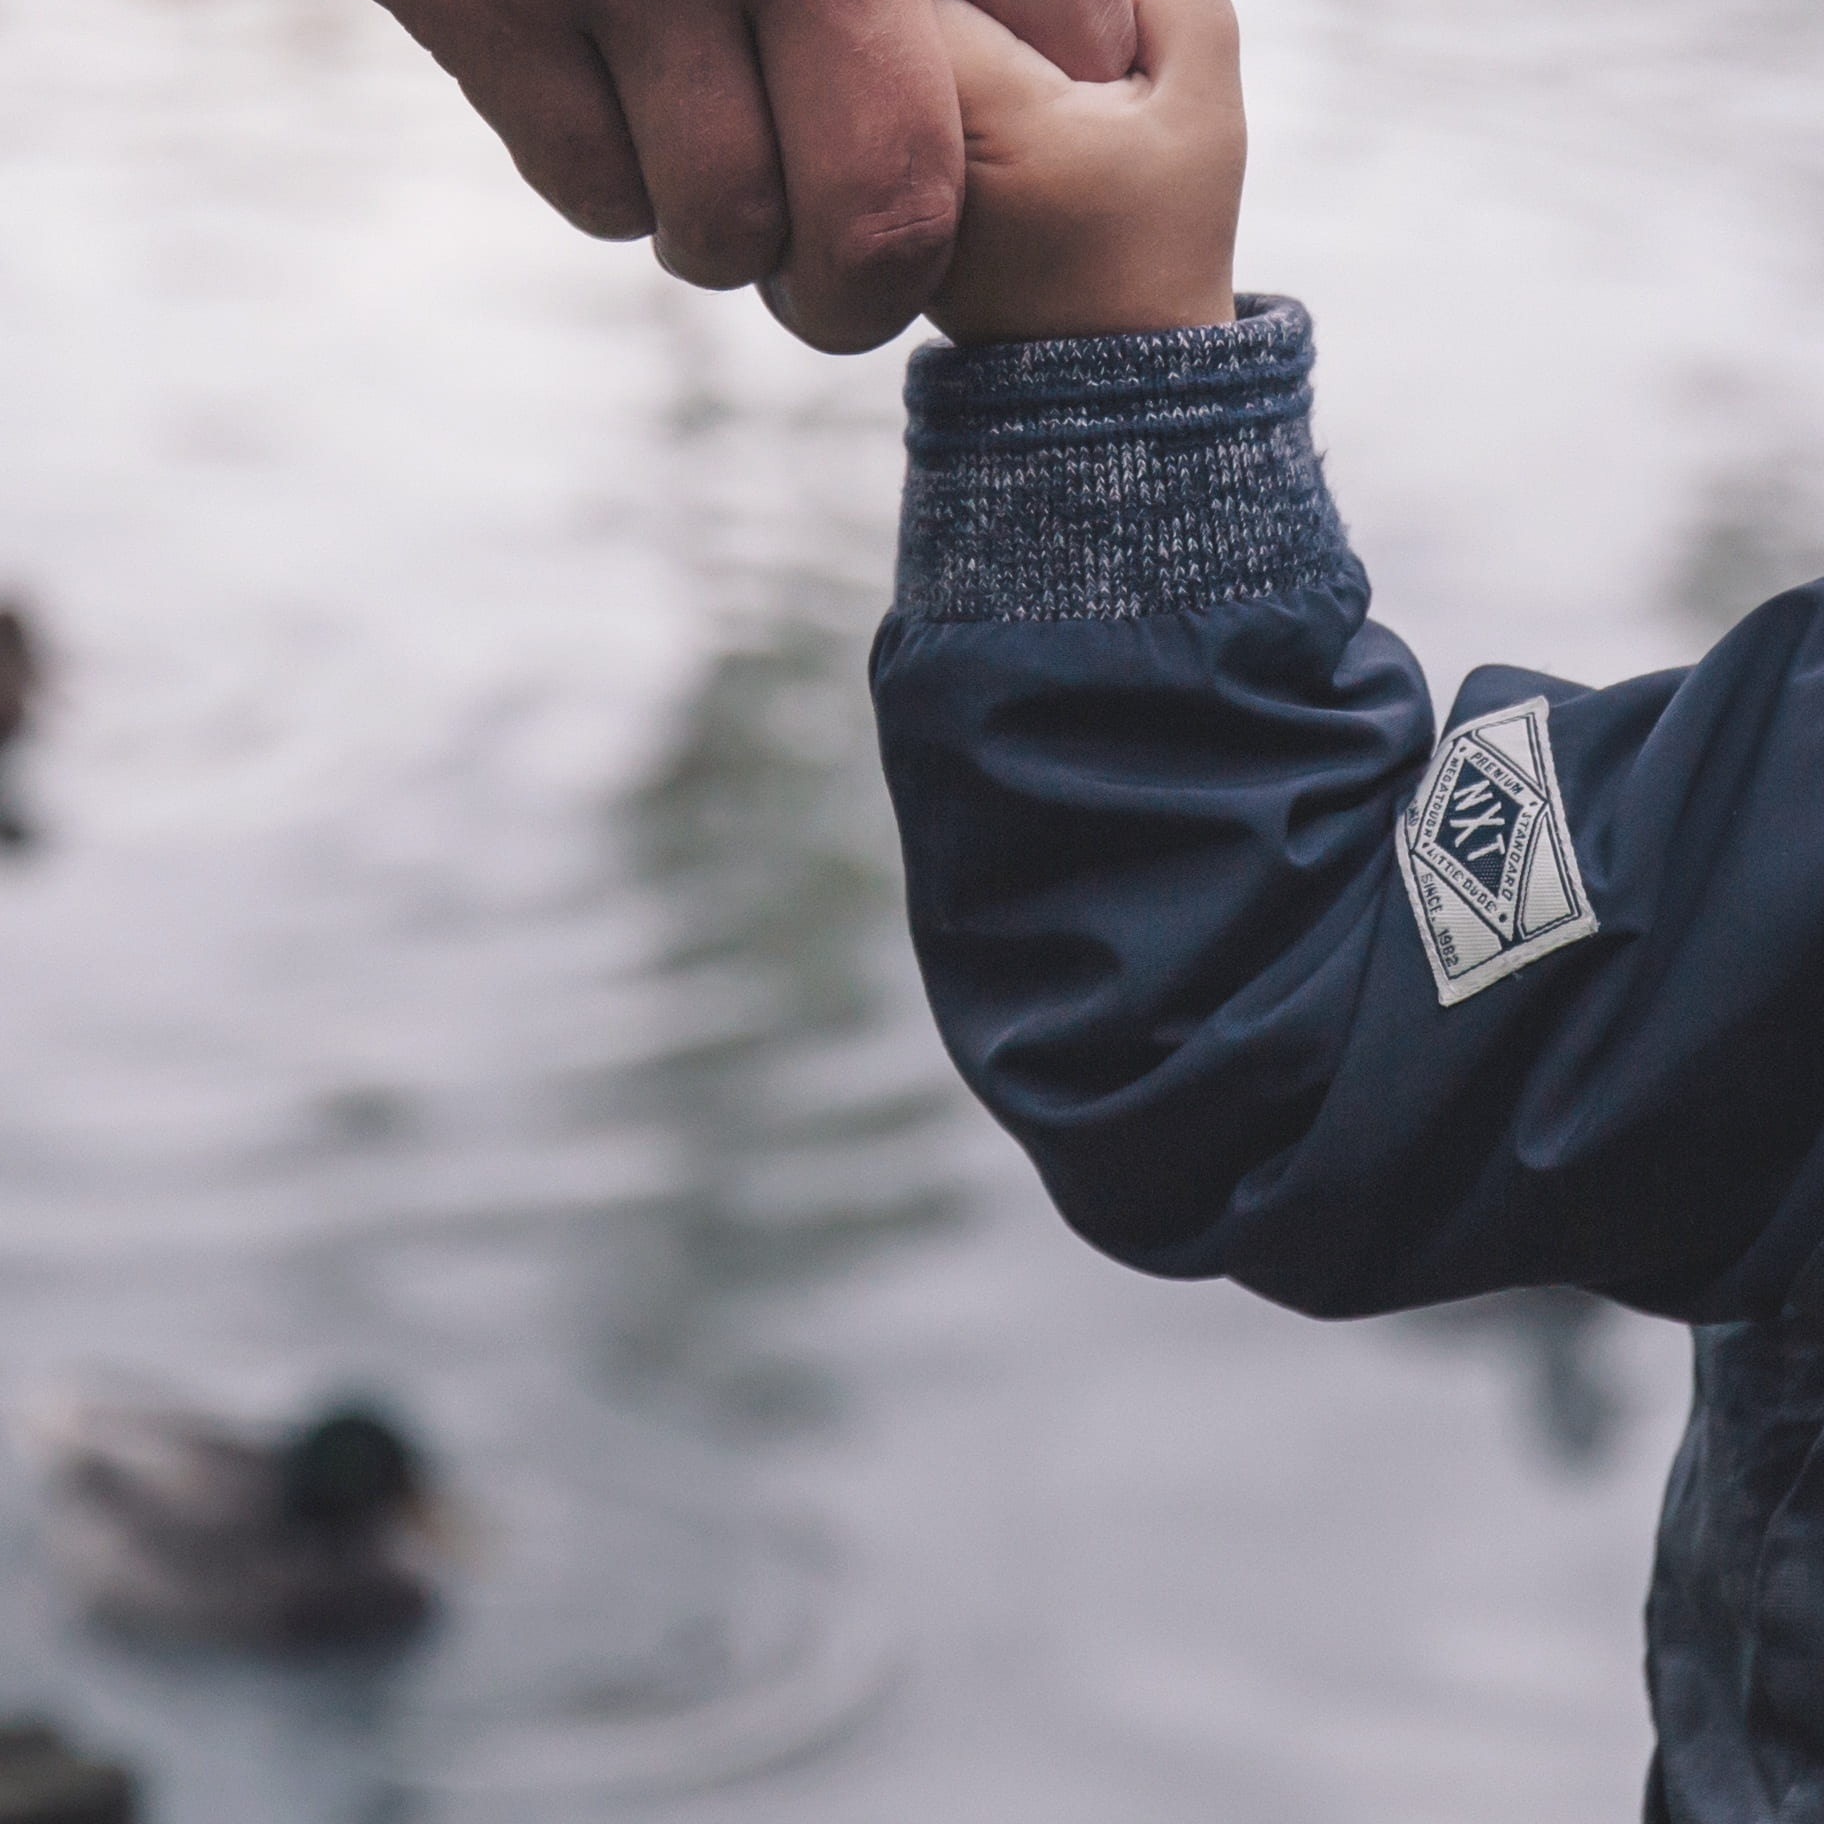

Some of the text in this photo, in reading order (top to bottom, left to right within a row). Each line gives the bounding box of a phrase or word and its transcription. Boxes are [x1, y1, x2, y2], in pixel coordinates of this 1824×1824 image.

[1470, 751, 1524, 796] PREMIUM
[1449, 779, 1507, 862] NXT
[1502, 811, 1532, 902] STANDARD
[1462, 878, 1498, 914] DUDE
[1437, 928, 1459, 968] 1982
